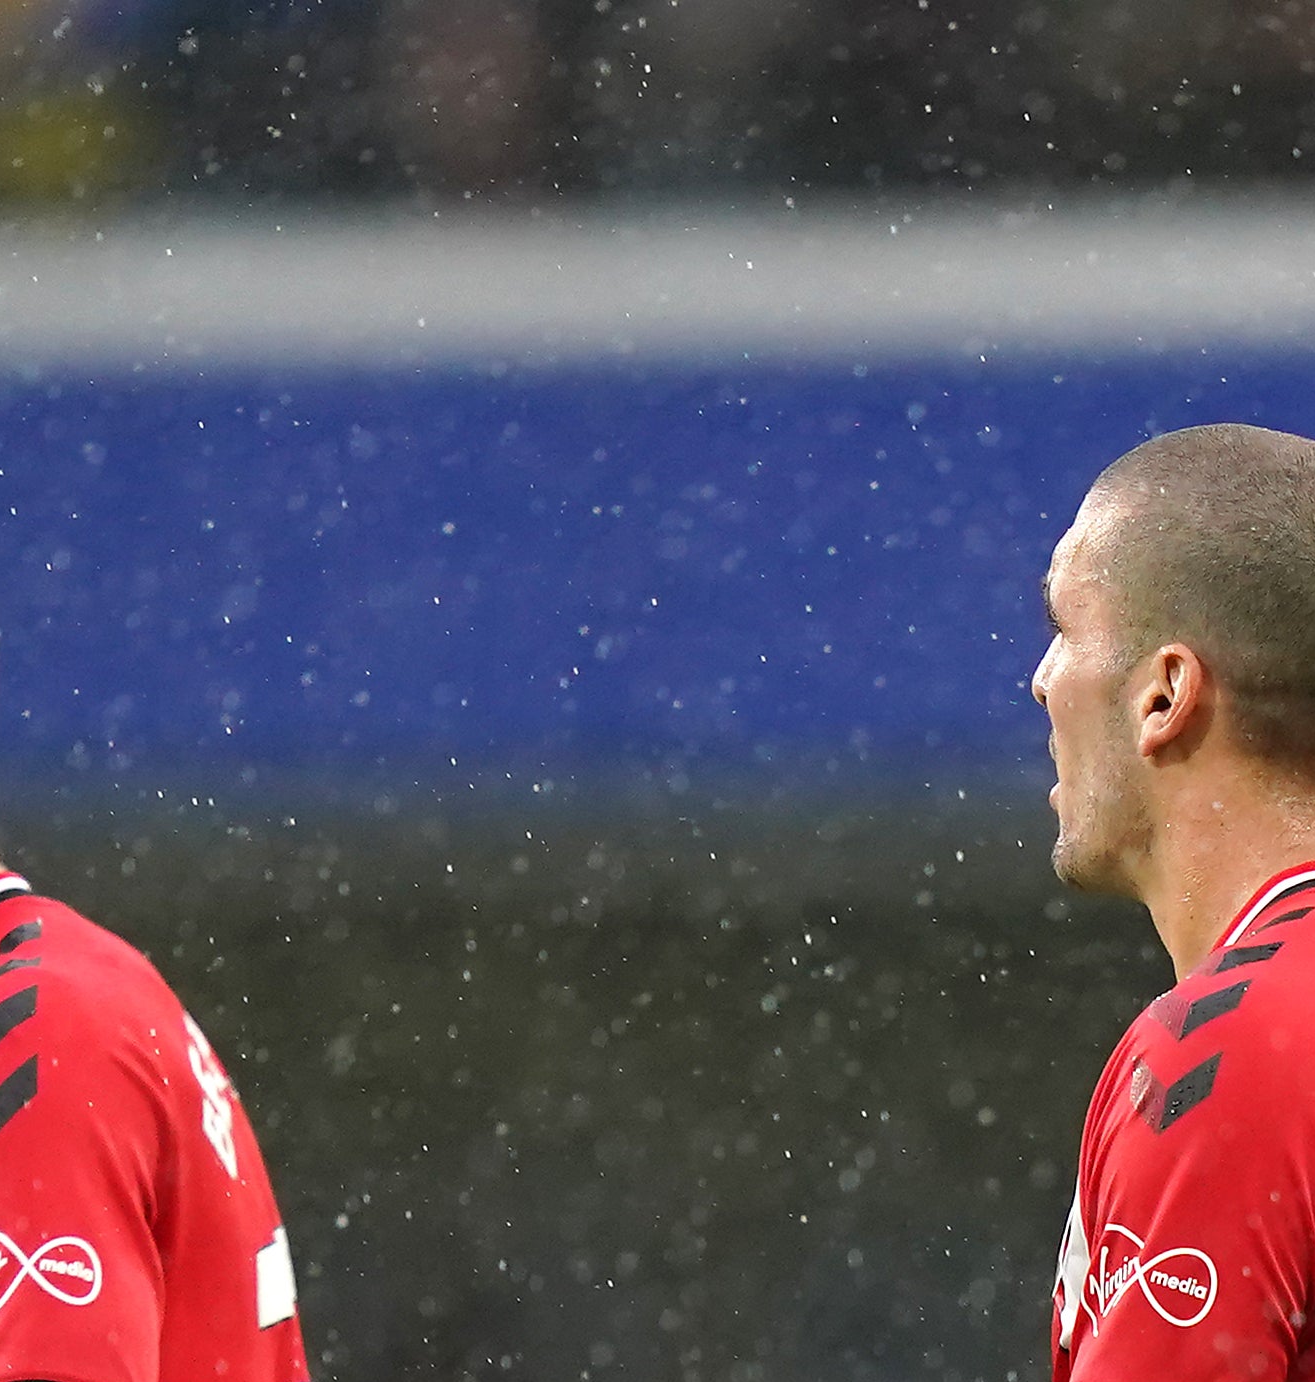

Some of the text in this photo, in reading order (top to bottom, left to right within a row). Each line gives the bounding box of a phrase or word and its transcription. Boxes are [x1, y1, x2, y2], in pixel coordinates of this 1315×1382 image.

[39, 1258, 94, 1283] media
[1088, 1246, 1208, 1318] Virgin media
